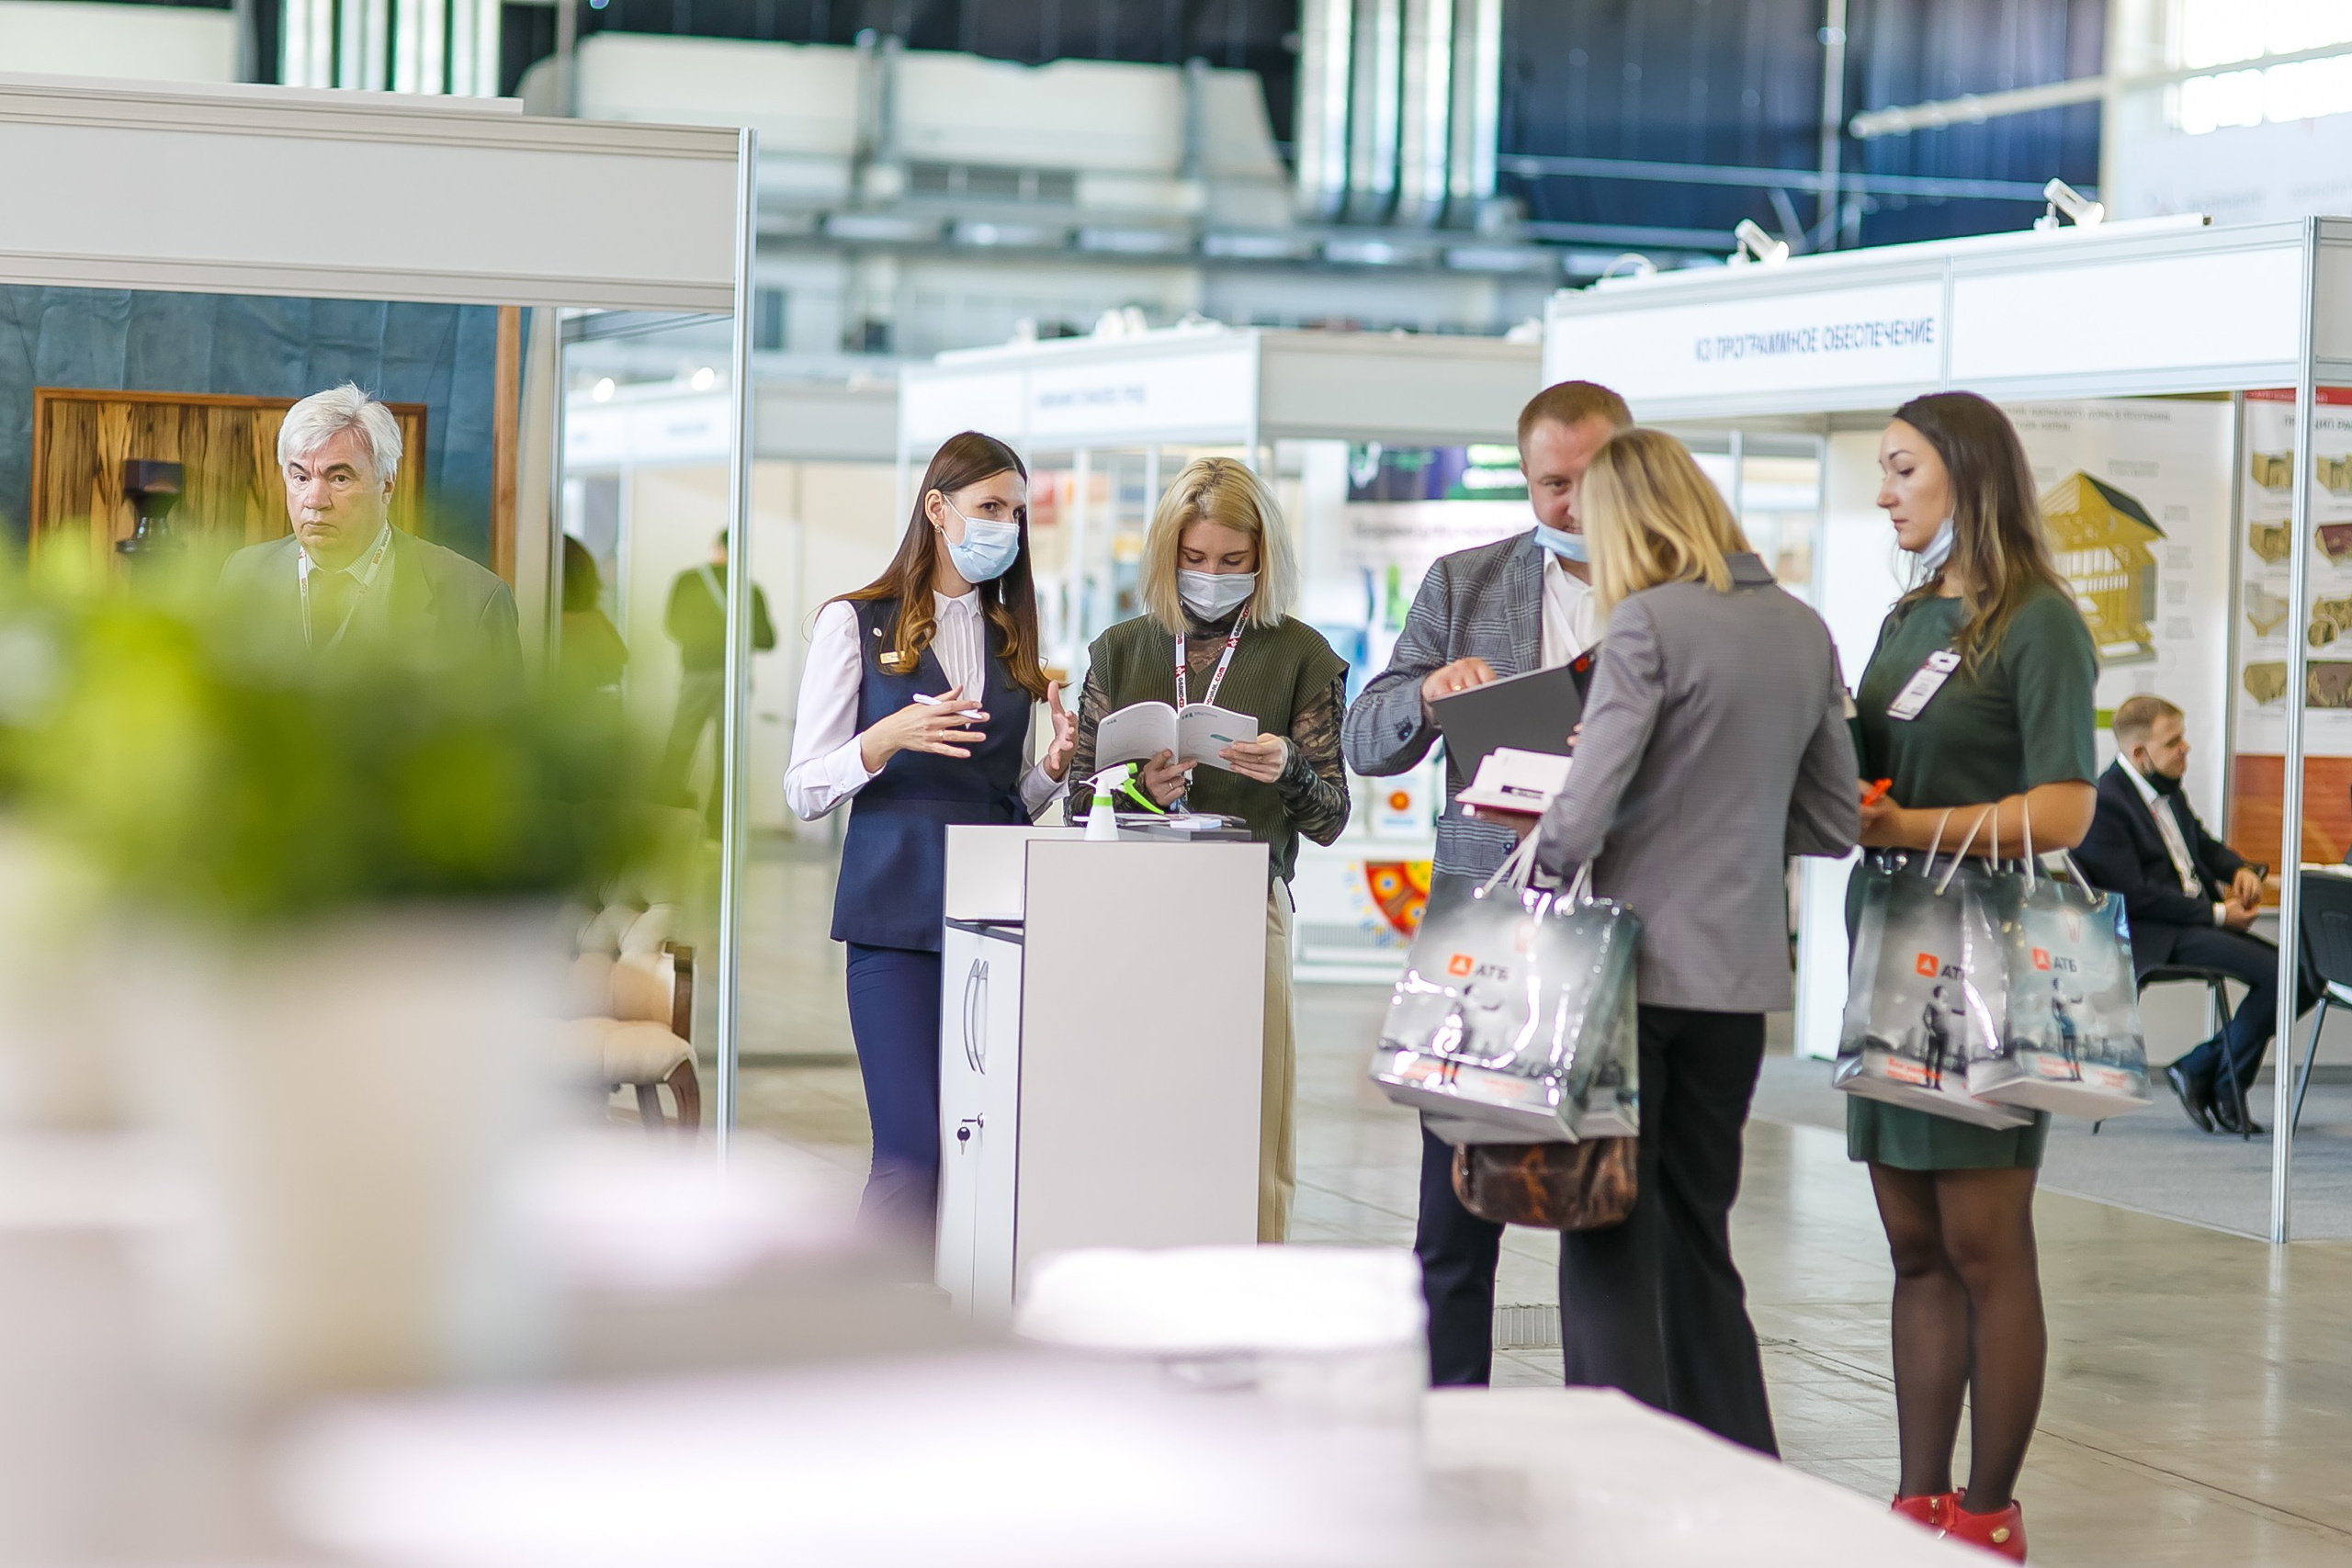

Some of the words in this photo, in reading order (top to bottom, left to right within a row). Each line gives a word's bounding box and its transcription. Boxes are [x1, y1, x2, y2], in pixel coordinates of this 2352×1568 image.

[1717, 328, 1818, 360] ПРОГРАММНОЕ
[1824, 318, 1935, 350] ОБЕСПЕЧЕНИЕ
[1940, 964, 1964, 981] АТ
